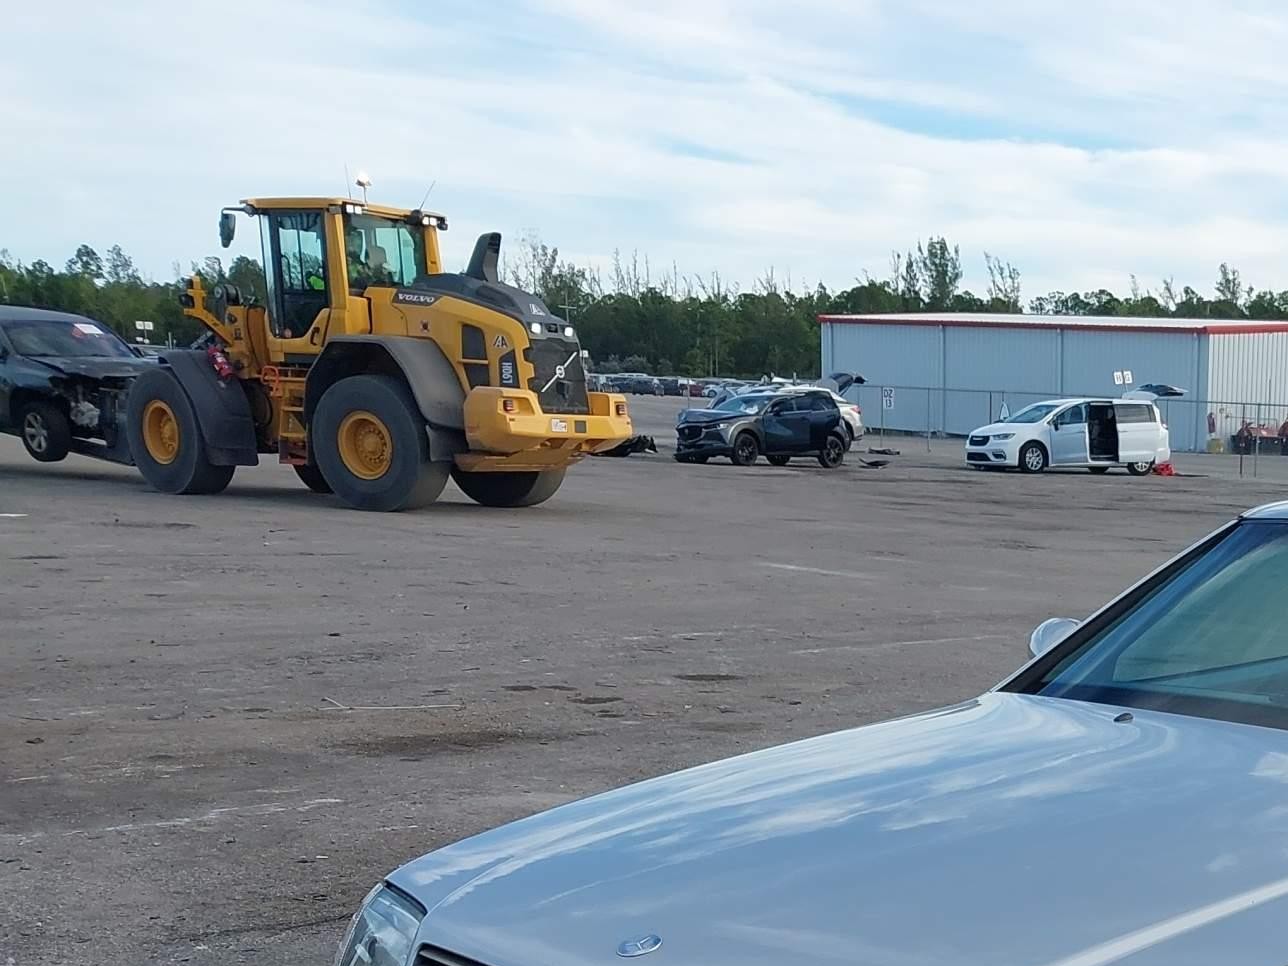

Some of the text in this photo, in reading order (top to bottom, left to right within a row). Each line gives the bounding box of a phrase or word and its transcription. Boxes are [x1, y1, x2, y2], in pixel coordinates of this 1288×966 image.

[398, 293, 435, 303] VOLVO
[502, 362, 512, 384] L90H
[883, 389, 893, 398] DZ
[885, 399, 892, 408] 13
